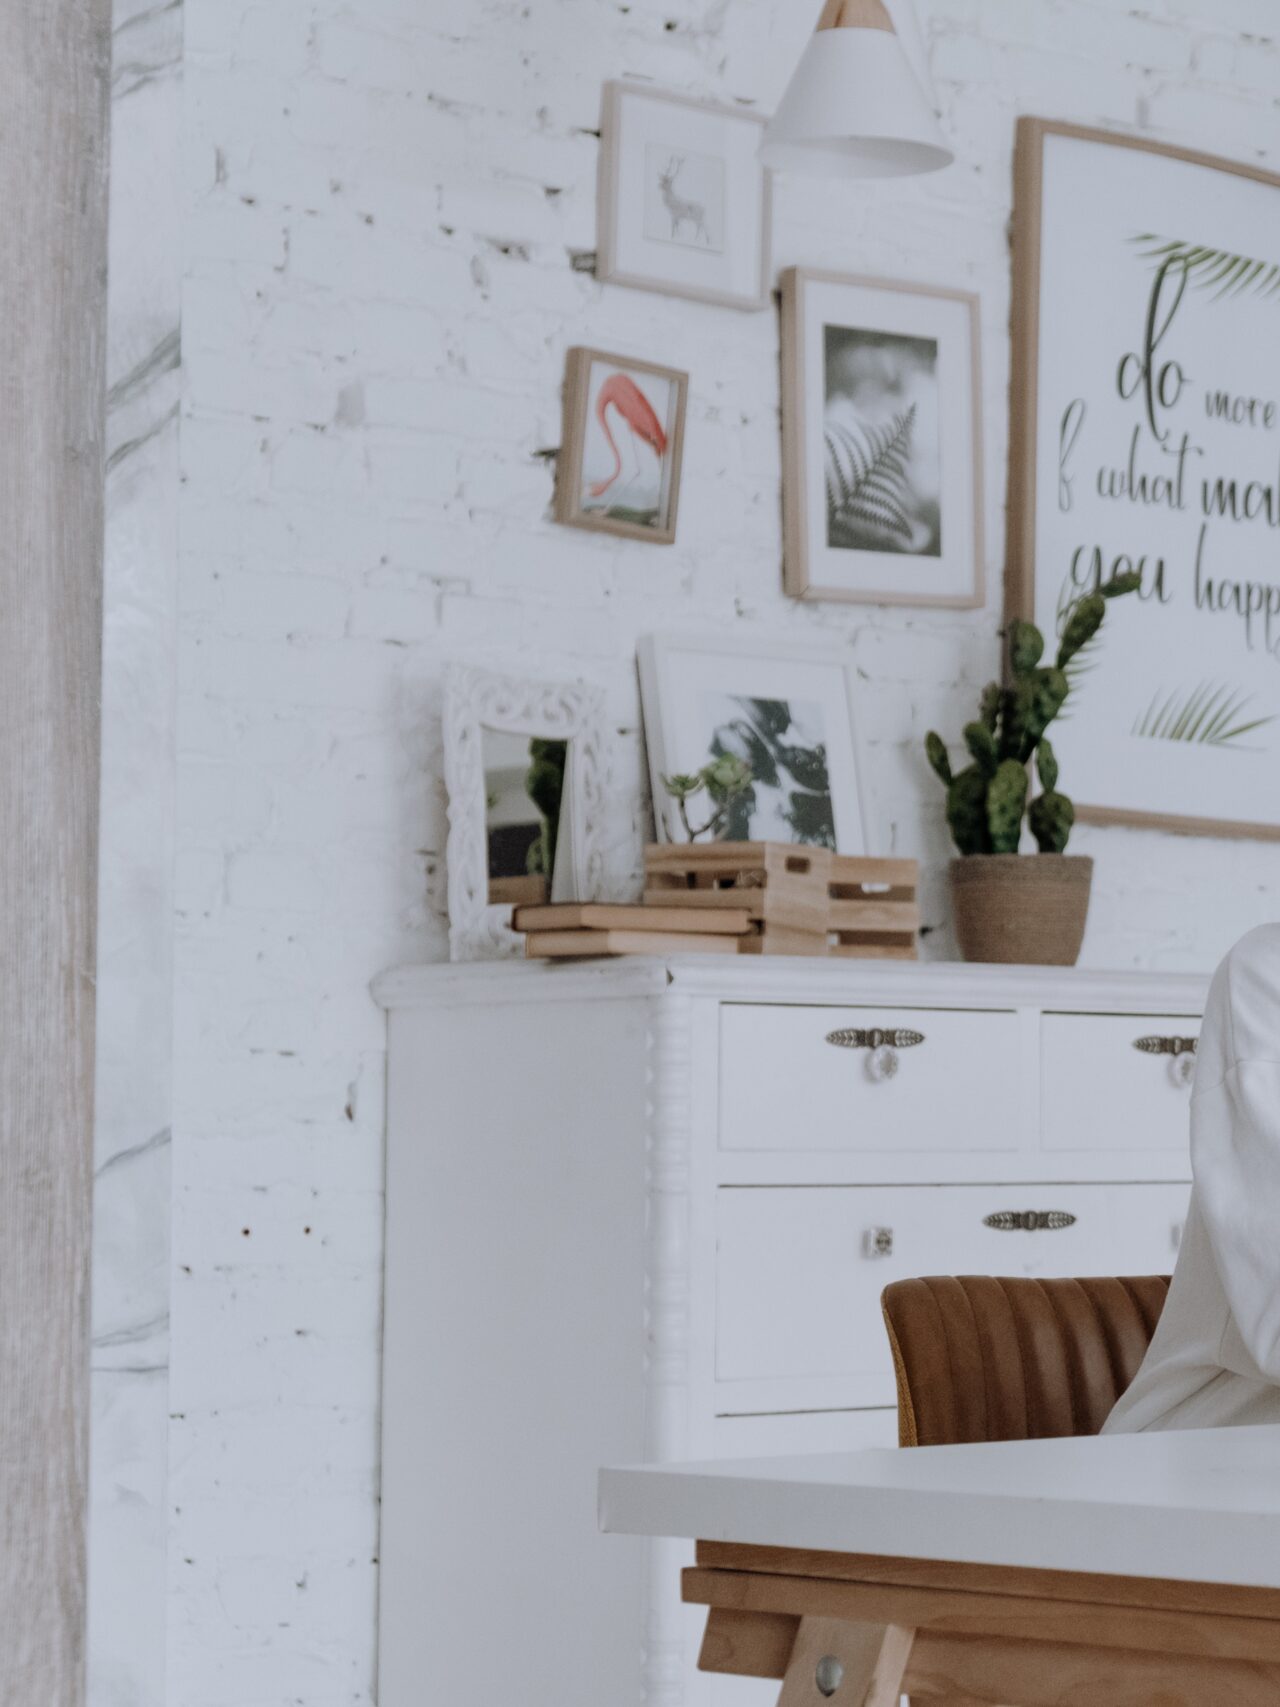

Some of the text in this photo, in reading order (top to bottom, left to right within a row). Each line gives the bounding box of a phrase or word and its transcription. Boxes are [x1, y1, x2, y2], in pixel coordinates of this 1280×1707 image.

[1116, 252, 1277, 442] do more
[1097, 423, 1203, 510] what
